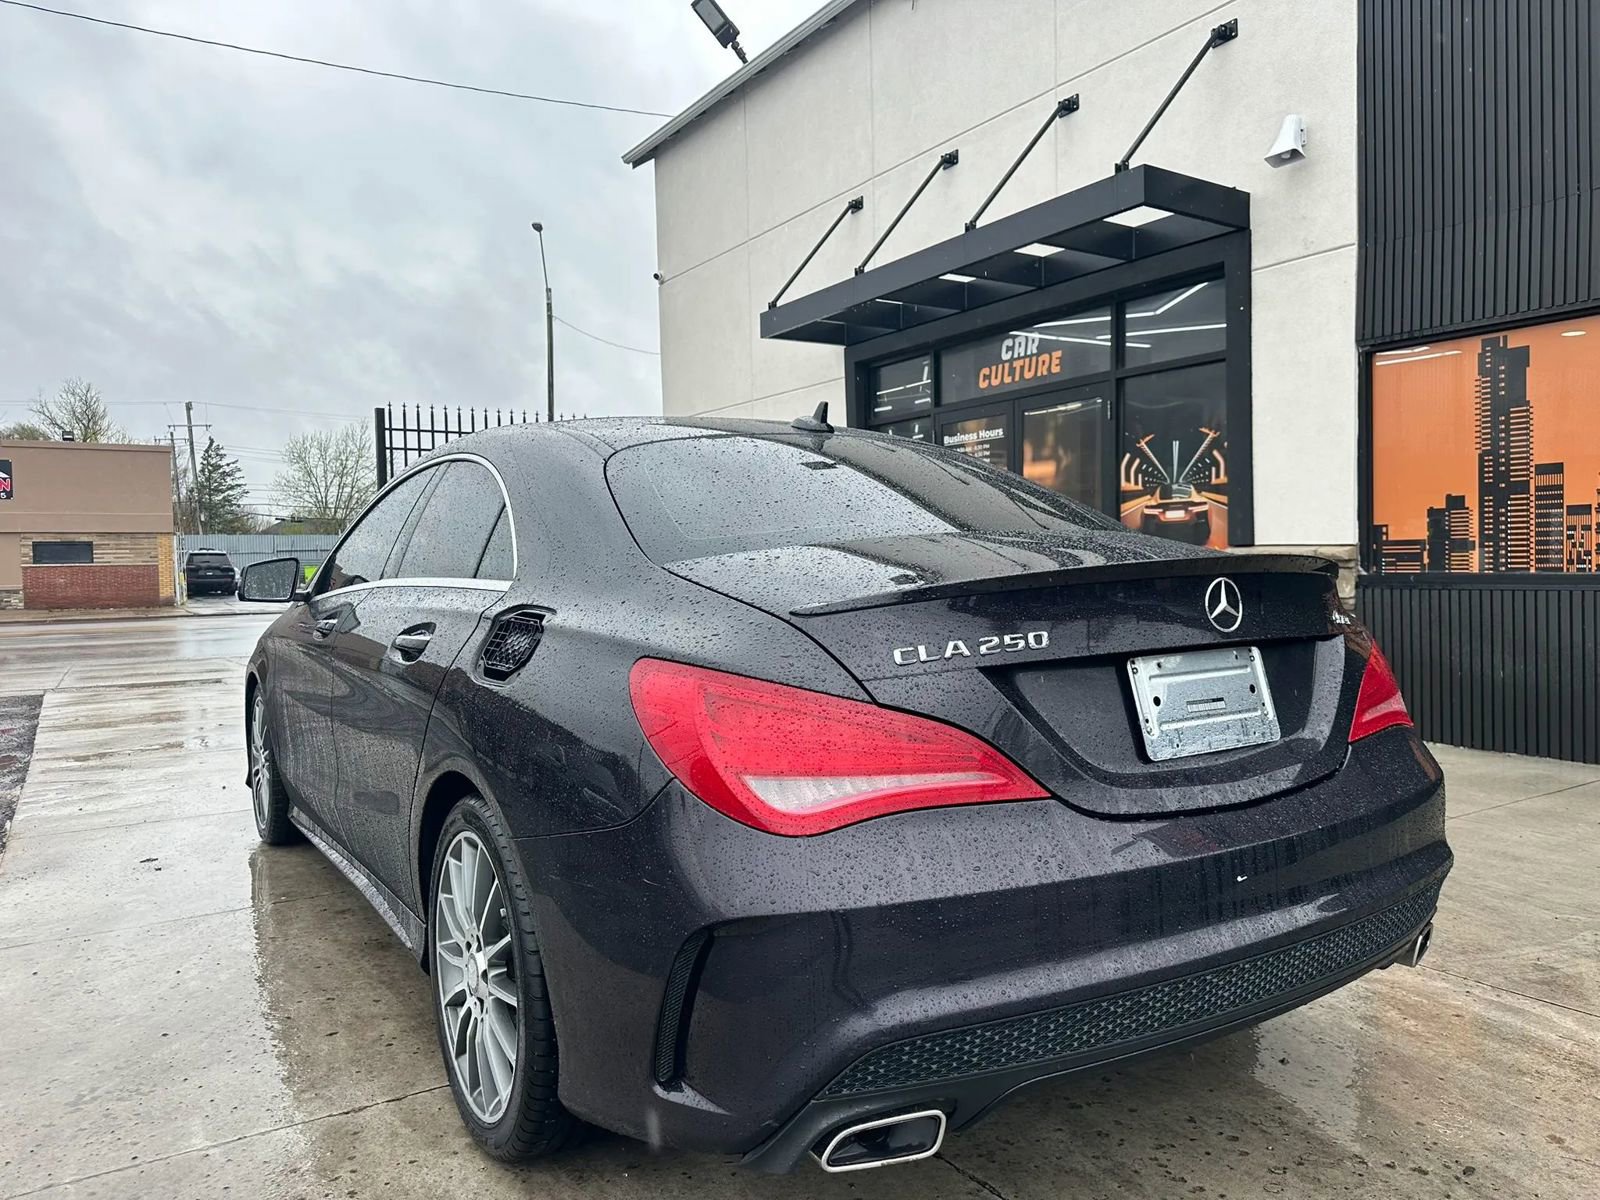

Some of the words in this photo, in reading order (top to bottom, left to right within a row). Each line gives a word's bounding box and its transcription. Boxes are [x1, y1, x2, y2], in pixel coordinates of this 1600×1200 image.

[1001, 333, 1039, 360] CAR
[978, 351, 1062, 389] CULTURE
[944, 432, 977, 444] Business
[978, 428, 1003, 438] Hours
[893, 640, 971, 665] CLA
[979, 631, 1050, 655] 250
